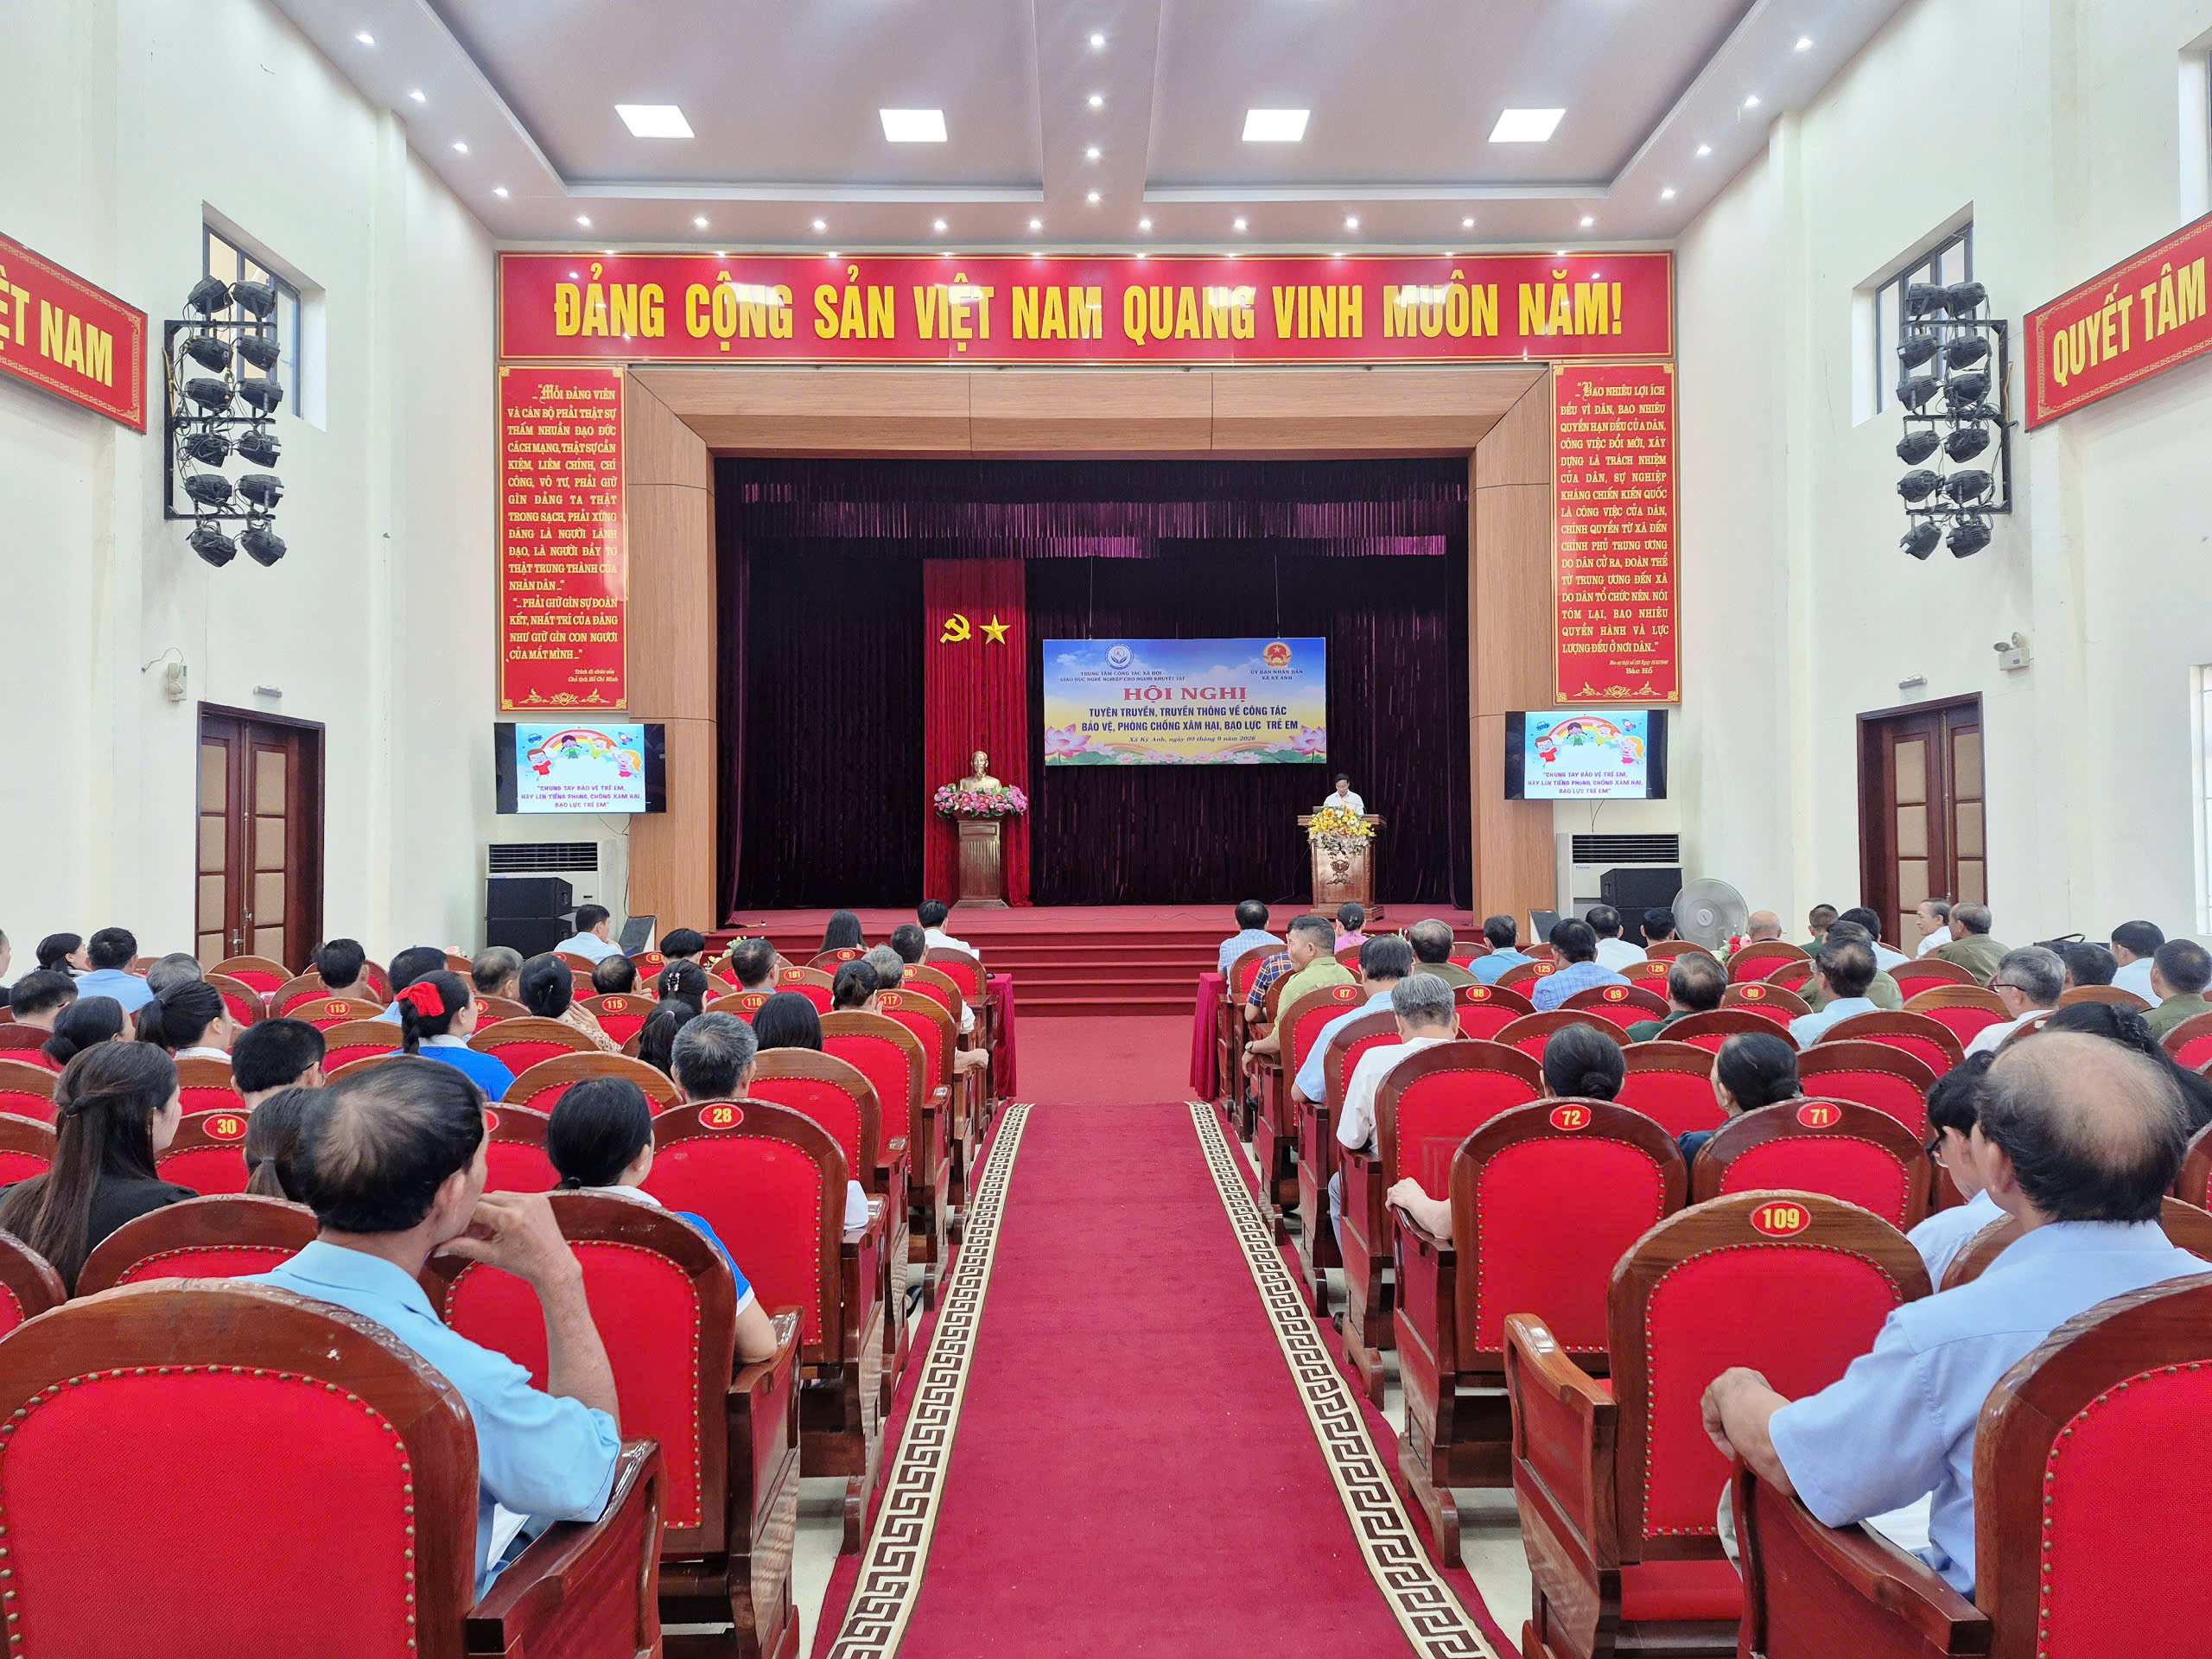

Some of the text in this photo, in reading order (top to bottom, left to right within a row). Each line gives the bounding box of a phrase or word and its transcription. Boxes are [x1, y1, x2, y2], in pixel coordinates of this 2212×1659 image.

[554, 263, 1622, 352] ĐẢNG CỘNG SẢN VIỆT NAM QUANG VINH MUÔN NĂM!
[2053, 257, 2206, 387] QUYẾT TÂM
[41, 299, 112, 387] NAM
[508, 404, 616, 420] VÀ CÁN BỘ PHẢI THẬT SỰ
[1560, 434, 1666, 451] CÔNG VIỆC ĐỔI MỚI, XÂY
[508, 458, 616, 472] KIỆM, LIÊM CHÍNH, CHÍ
[1560, 453, 1666, 468] DỰNG LÀ TRÁCH NHIỆM
[508, 474, 618, 488] CÔNG, VÔ TƯ, PHẢI GIỮ
[1560, 470, 1666, 484] CỦA DÂN, SỰ NGHIỆP
[508, 491, 616, 506] GÌN ĐẢNG TA THẬT
[1561, 486, 1667, 499] KHÁNG CHIẾN KIẾN QUỐC
[508, 508, 616, 524] TRONG SẠCH, PHẢI XỨNG
[1562, 552, 1668, 569] DO DÂN CỬ RA, ĐOÀN THỂ
[1561, 571, 1668, 585] TỪ TRUNG ƯƠNG ĐẾN XÃ
[510, 612, 618, 626] KẾT, NHẤT TRÍ CỦA ĐẢNG
[1562, 607, 1668, 620] TÓM LẠI, BAO NHIÊU
[510, 632, 529, 642] NHƯ
[531, 631, 547, 642] GIỮ
[550, 631, 566, 642] GÌN
[569, 633, 587, 642] CON
[1123, 685, 1247, 702] HỘI NGHỊ
[1090, 705, 1287, 717] TUYÊN TRUYỀN, TRUYỀN THÔNG VỀ CÔNG TÁC
[1082, 721, 1099, 731] BẢO
[1103, 721, 1116, 733] VỆ,
[1118, 721, 1147, 731] PHÒNG
[1151, 720, 1179, 731] CHỐNG
[1183, 720, 1202, 730] XÂM
[1205, 721, 1222, 732] HẠI,
[1224, 721, 1242, 732] BẠO
[1245, 720, 1262, 731] LỰC
[1267, 718, 1281, 729] TRẺ
[788, 969, 801, 979] 101
[904, 969, 913, 977] 00
[1537, 964, 1550, 973] 125
[1340, 988, 1351, 998] 87
[1473, 988, 1484, 997] 88
[1610, 989, 1621, 999] 89
[1747, 988, 1758, 997] 90
[607, 999, 623, 1009] 115
[746, 996, 762, 1007] 116
[883, 995, 898, 1005] 117
[329, 1003, 346, 1013] 113
[713, 1109, 732, 1123] 28
[1562, 1111, 1581, 1125] 72
[1810, 1109, 1827, 1123] 71
[217, 1119, 236, 1134] 30
[1762, 1208, 1800, 1230] 109
